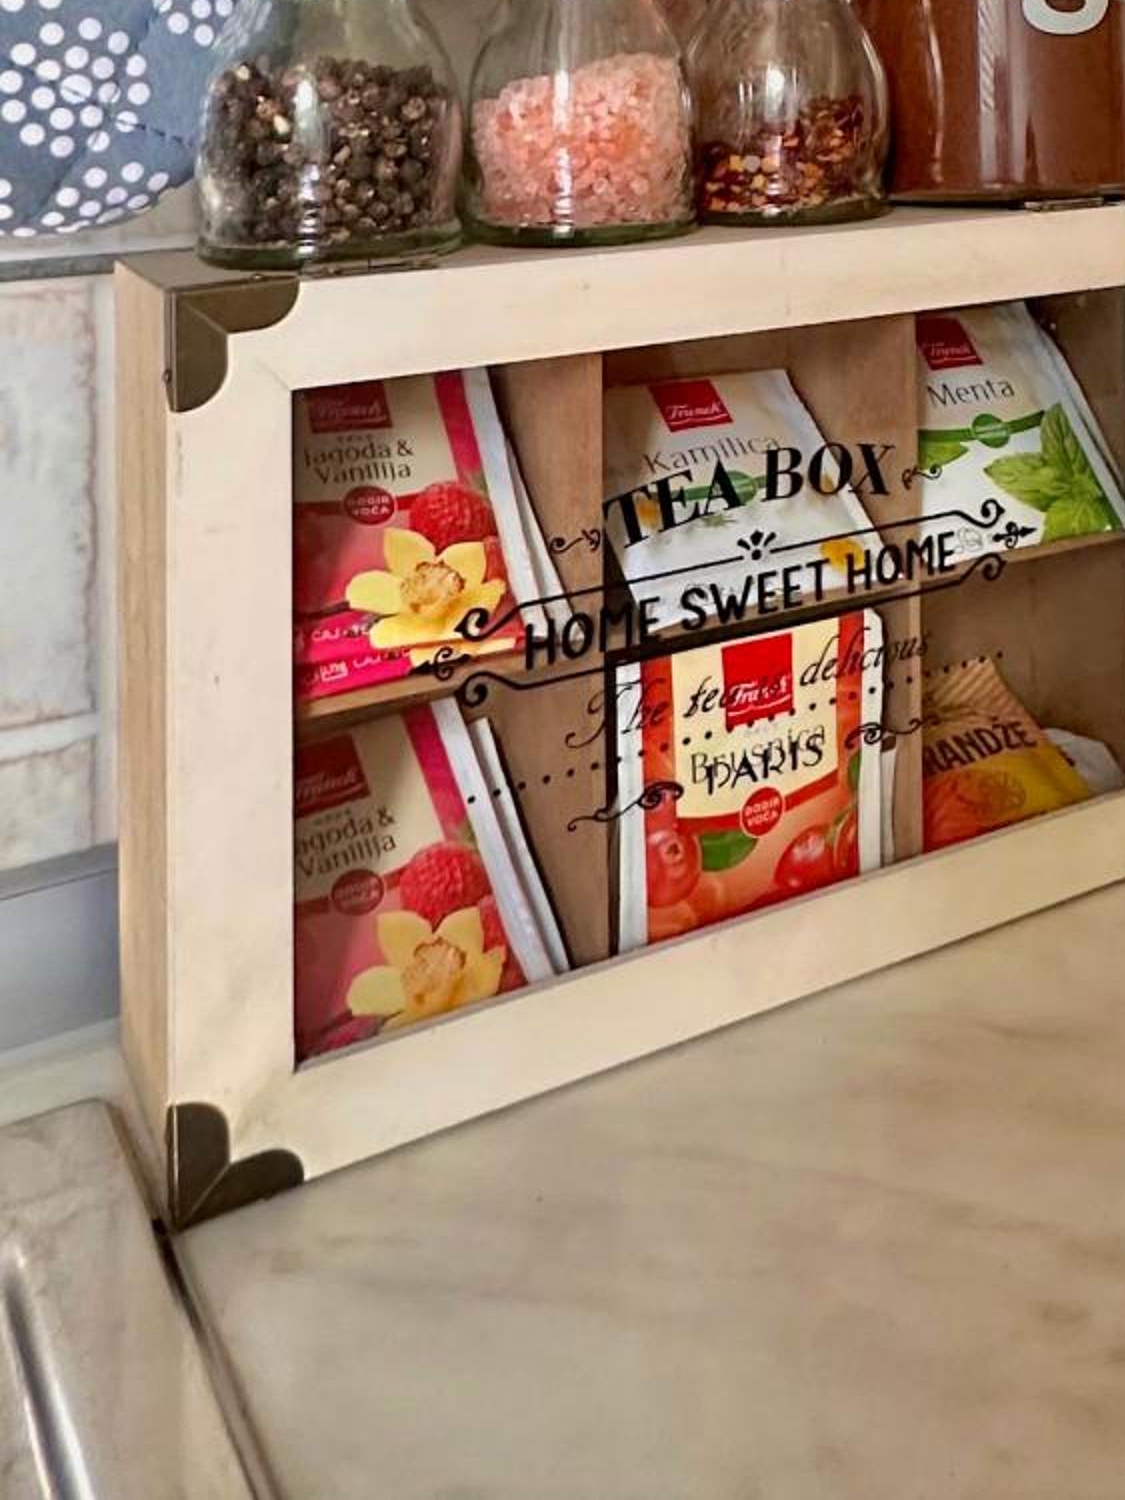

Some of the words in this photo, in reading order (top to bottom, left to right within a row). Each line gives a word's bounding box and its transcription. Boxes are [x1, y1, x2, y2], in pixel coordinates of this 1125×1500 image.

[926, 378, 1016, 407] Menta
[396, 438, 415, 456] &
[642, 434, 782, 475] Kamilica
[601, 457, 746, 549] TEA
[761, 441, 897, 502] BOX
[525, 595, 662, 671] HOME
[680, 557, 832, 631] SWEET
[846, 530, 956, 594] HOME
[704, 732, 825, 796] PARIS
[376, 806, 396, 827] &
